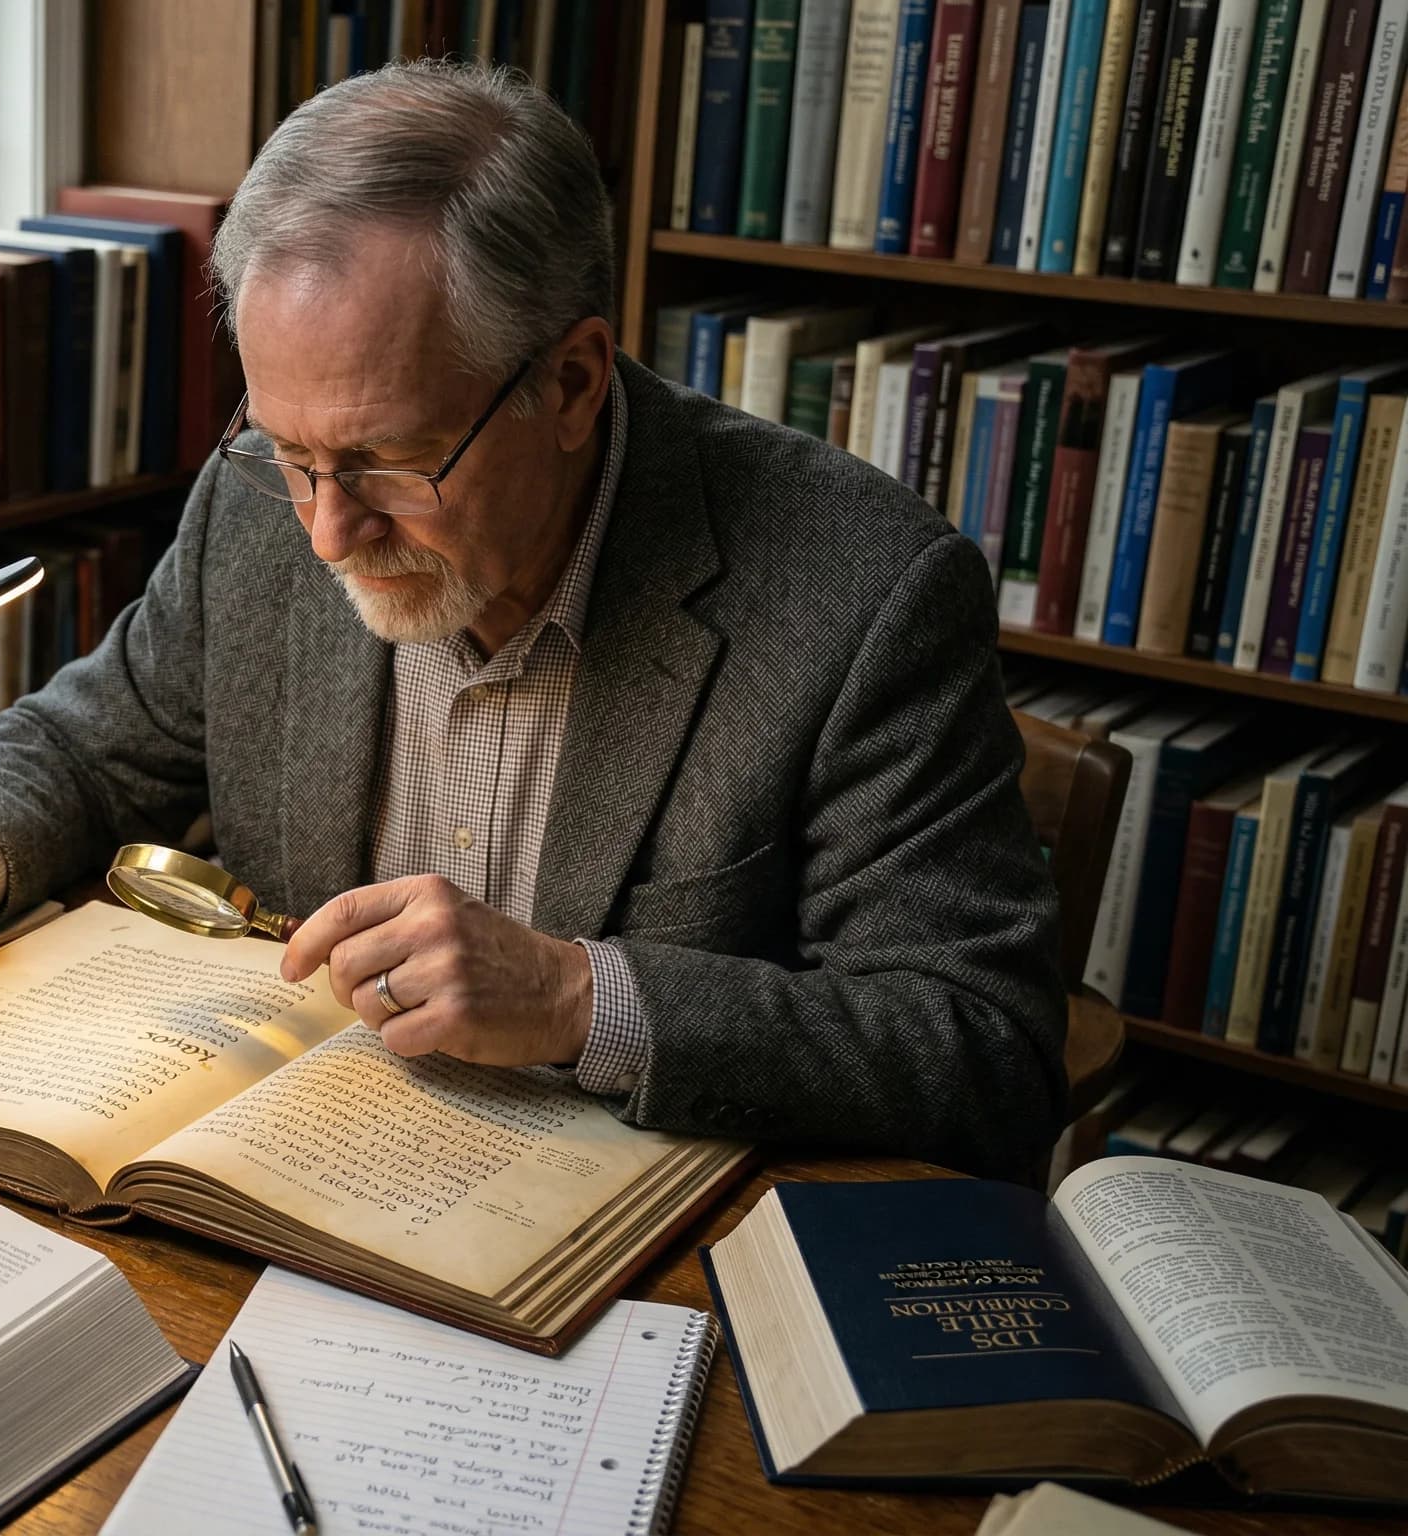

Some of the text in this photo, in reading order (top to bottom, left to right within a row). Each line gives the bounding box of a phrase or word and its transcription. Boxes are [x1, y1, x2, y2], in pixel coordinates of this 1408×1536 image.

[890, 1298, 1071, 1317] COMBIATION
[937, 1312, 1044, 1332] TRILE
[970, 1329, 1042, 1349] LDS
